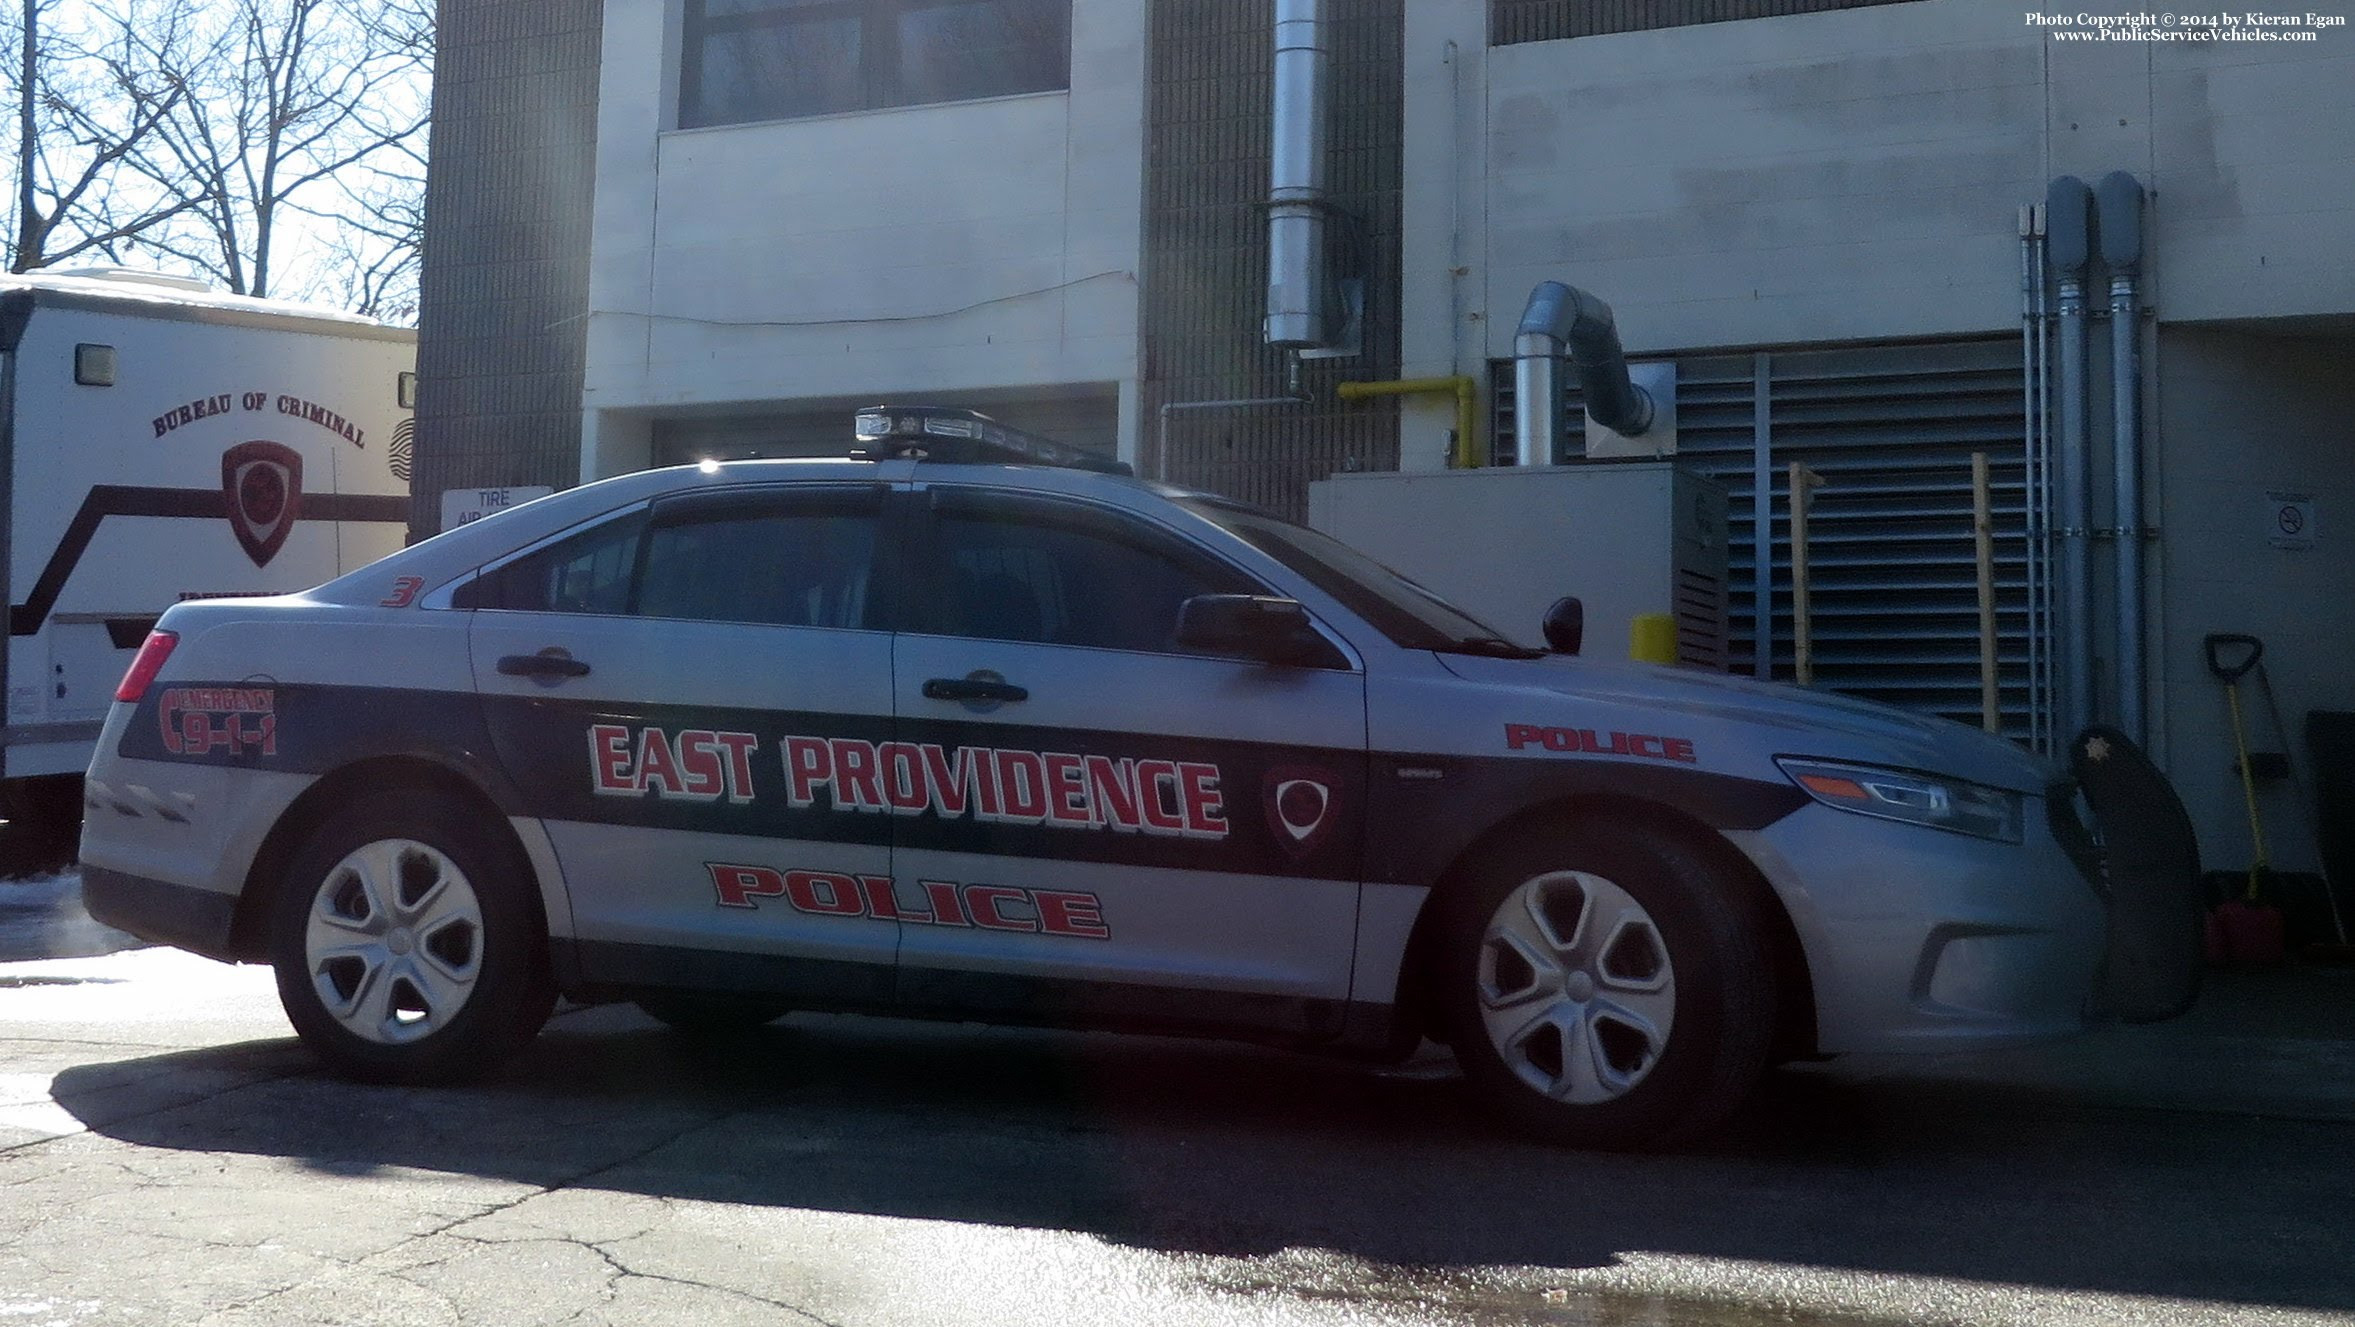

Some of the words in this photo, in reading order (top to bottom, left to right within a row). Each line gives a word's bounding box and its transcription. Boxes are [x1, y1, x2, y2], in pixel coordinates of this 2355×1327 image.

[152, 394, 232, 439] BUREAU
[242, 392, 267, 411] OF
[276, 395, 365, 449] CRIMINAL
[479, 490, 510, 507] TIRE
[379, 575, 425, 608] 3
[180, 687, 274, 712] EMERGENCY
[182, 711, 277, 755] 9-1-1
[1504, 723, 1697, 764] POLICE
[587, 724, 758, 804] EAST
[780, 735, 1229, 839] PROVIDENCE
[703, 862, 1111, 940] POLICE
